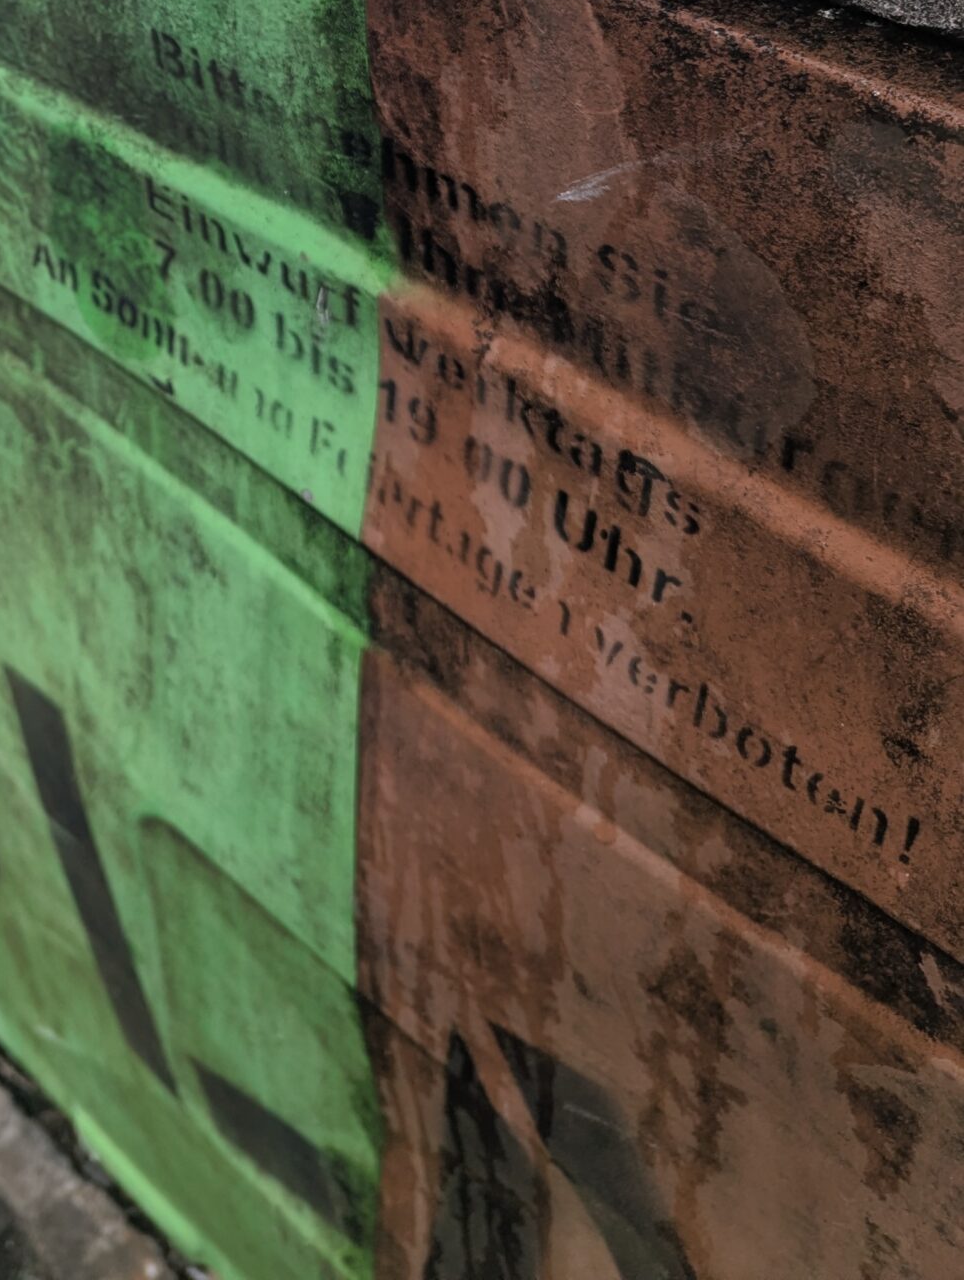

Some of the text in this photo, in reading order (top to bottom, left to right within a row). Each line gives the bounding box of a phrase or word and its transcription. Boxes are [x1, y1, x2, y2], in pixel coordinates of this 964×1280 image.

[146, 175, 362, 328] Einwurf
[386, 317, 702, 537] werktags
[273, 311, 355, 396] bis
[33, 242, 80, 293] An
[592, 624, 922, 865] verboten!
